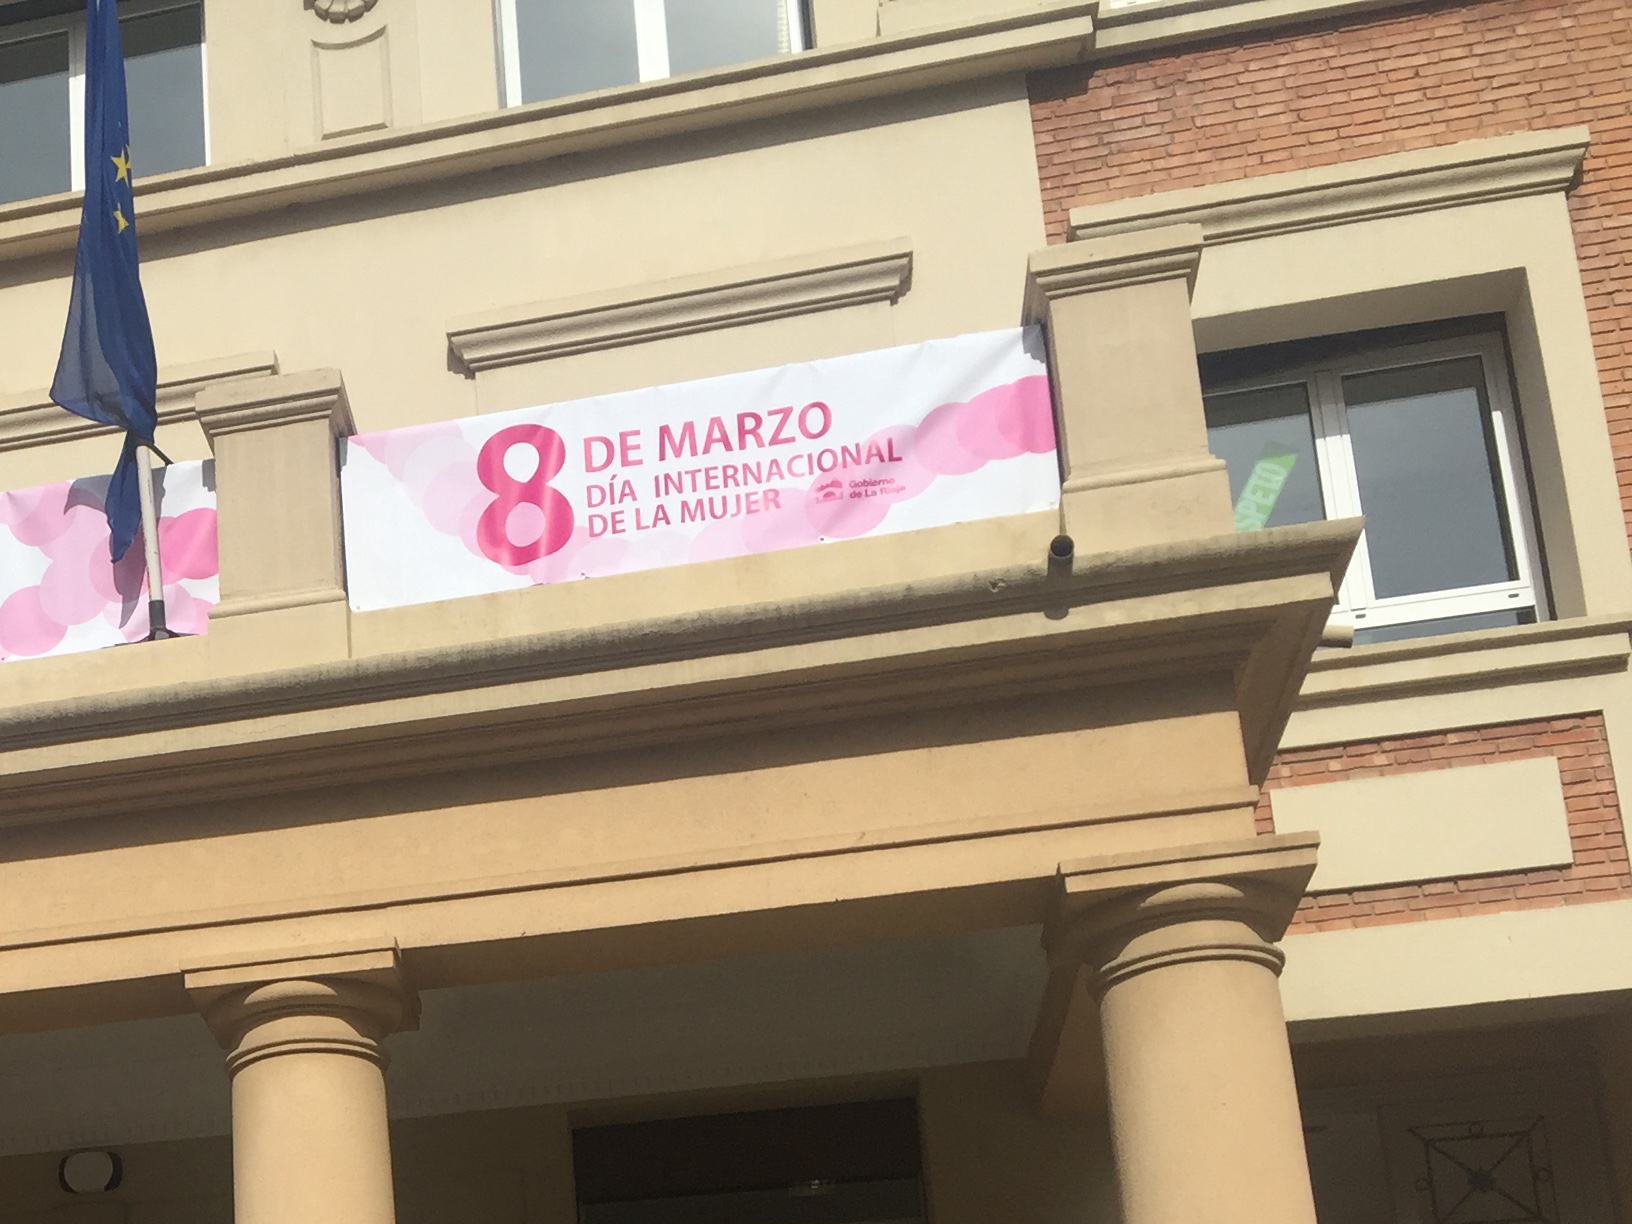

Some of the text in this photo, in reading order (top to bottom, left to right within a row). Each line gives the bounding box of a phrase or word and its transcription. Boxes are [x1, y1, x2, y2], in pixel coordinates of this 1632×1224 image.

[584, 401, 832, 472] DE MARZO
[476, 423, 575, 566] 8
[586, 438, 903, 508] DÍA INTERNACIONAL
[587, 488, 781, 538] DE LA MUJER
